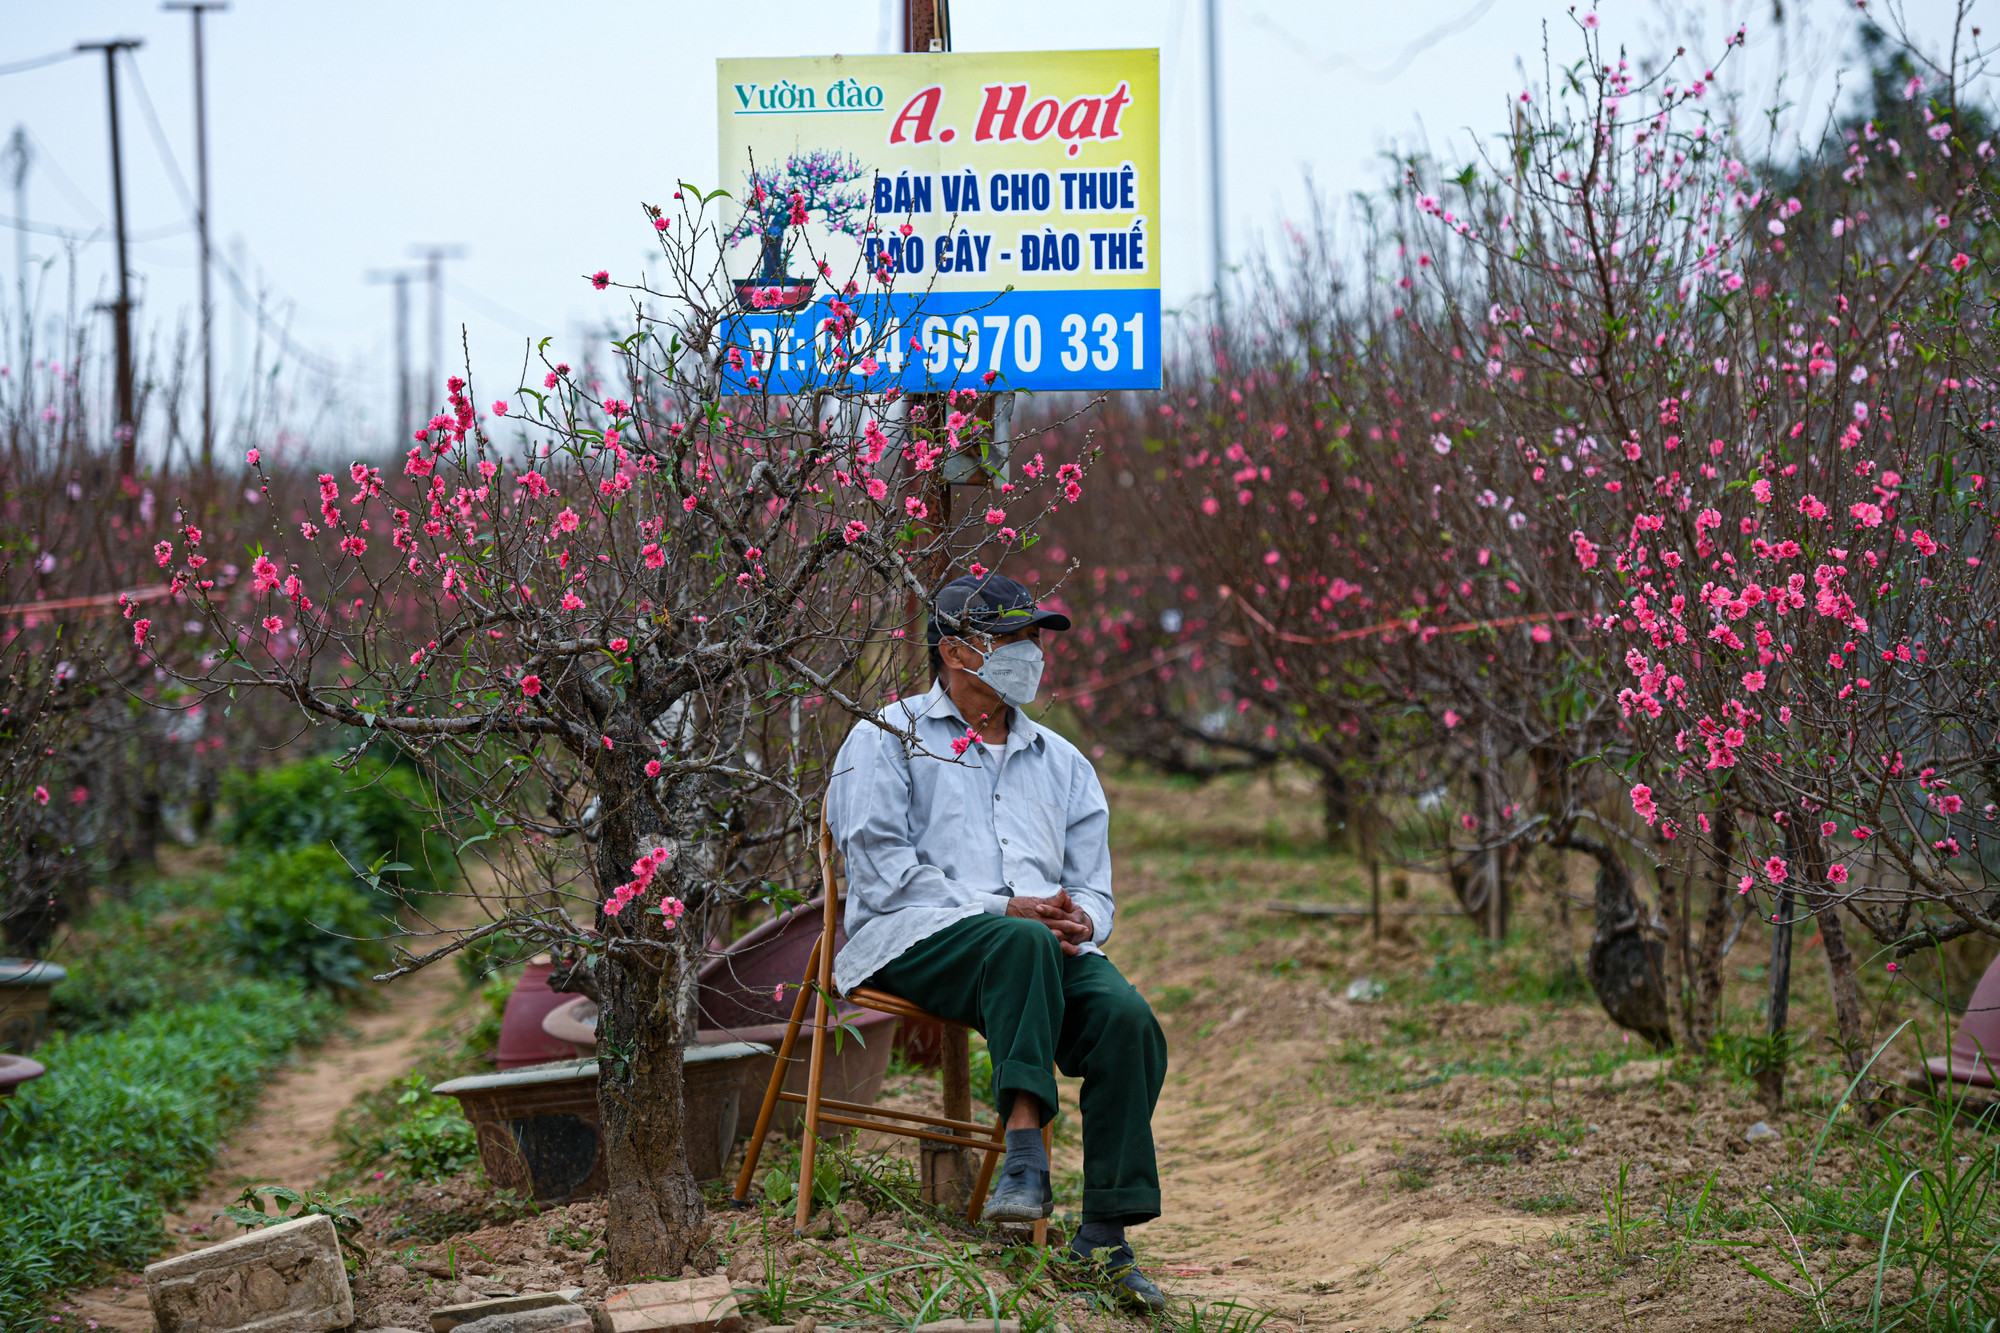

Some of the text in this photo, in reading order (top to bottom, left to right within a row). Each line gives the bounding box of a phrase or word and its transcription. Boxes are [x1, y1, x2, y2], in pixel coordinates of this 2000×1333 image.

[735, 78, 884, 109] Vườn đào
[890, 84, 1130, 156] A. Hoạt
[874, 165, 1134, 213] BÁN VÀ CHO THUÊ
[866, 231, 924, 274] ĐÀO
[935, 229, 991, 272] CÂY
[1021, 228, 1080, 271] ĐÀO
[1090, 219, 1144, 270] THẾ
[748, 328, 805, 371] ĐT:
[922, 314, 1041, 373] 9970
[1060, 312, 1143, 371] 331
